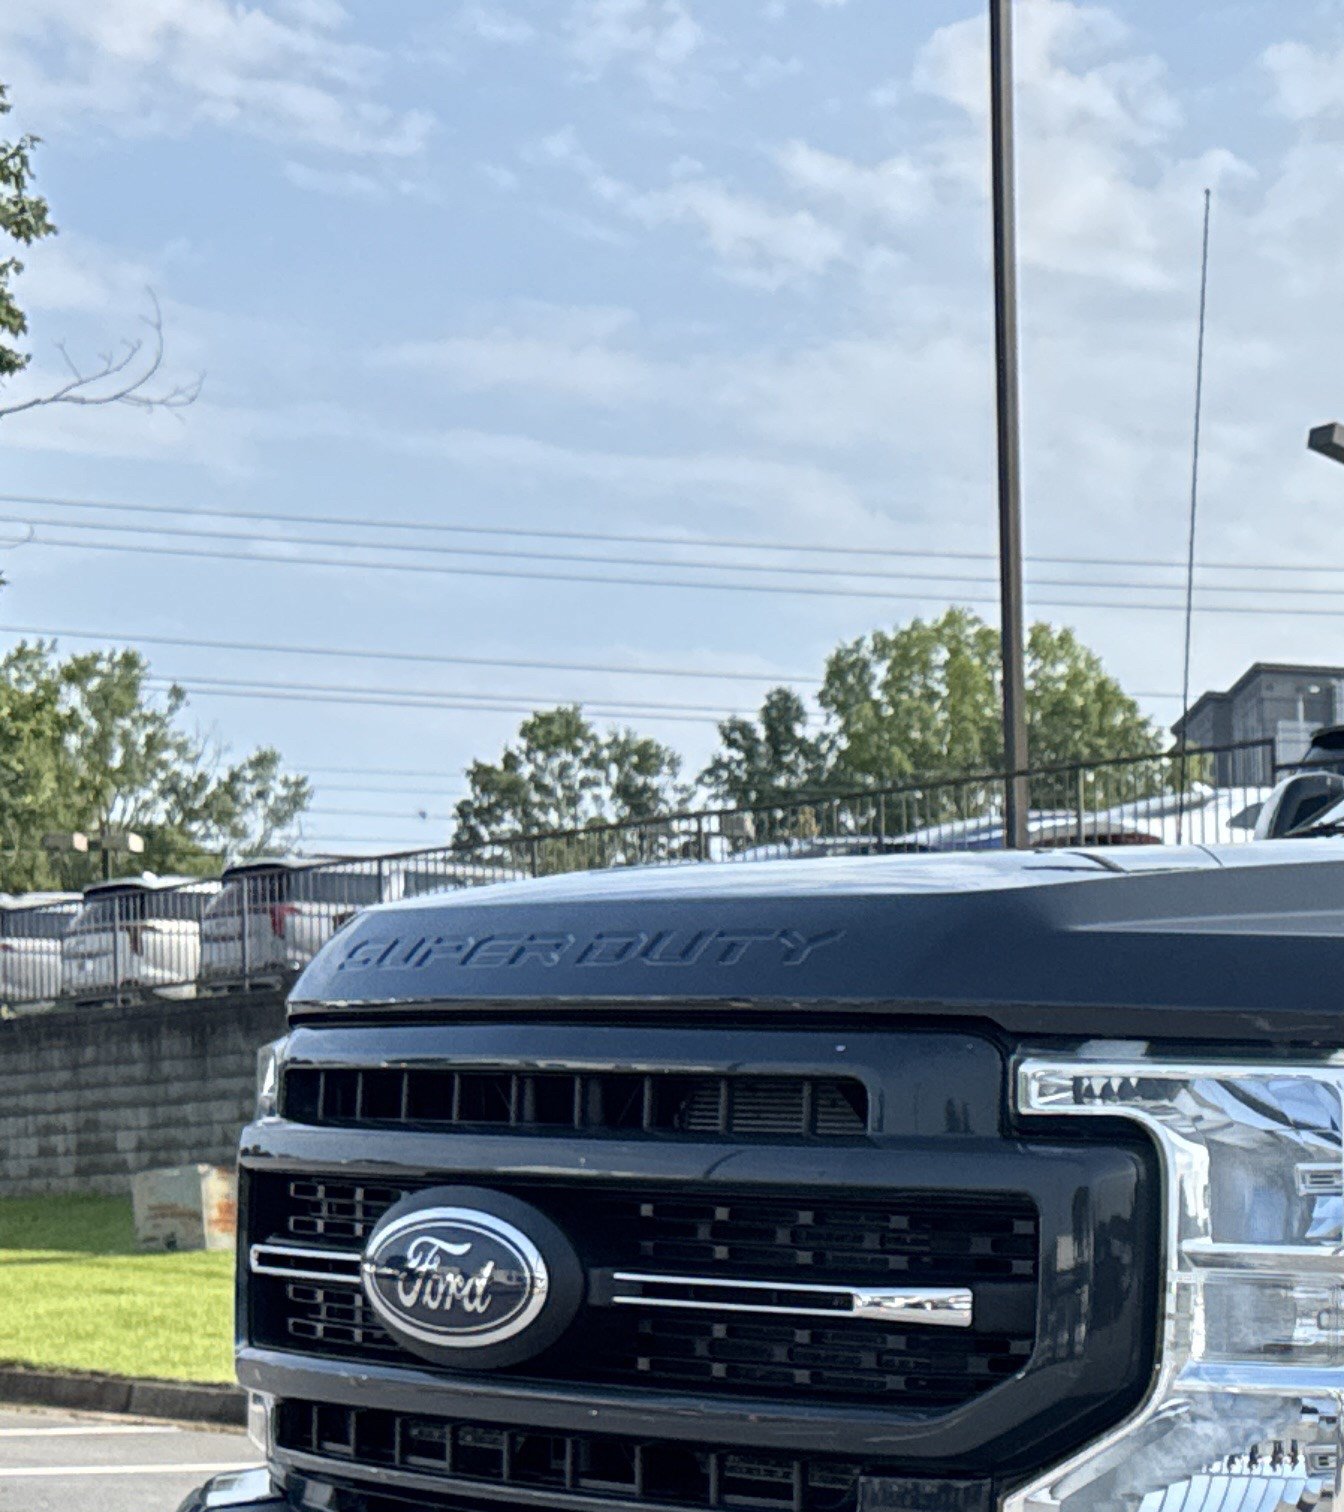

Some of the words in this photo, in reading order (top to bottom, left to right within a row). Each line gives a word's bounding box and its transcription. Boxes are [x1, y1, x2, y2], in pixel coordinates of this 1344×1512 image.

[336, 931, 577, 972] SUPER
[574, 928, 848, 970] DUTY
[396, 1234, 496, 1315] Ford
